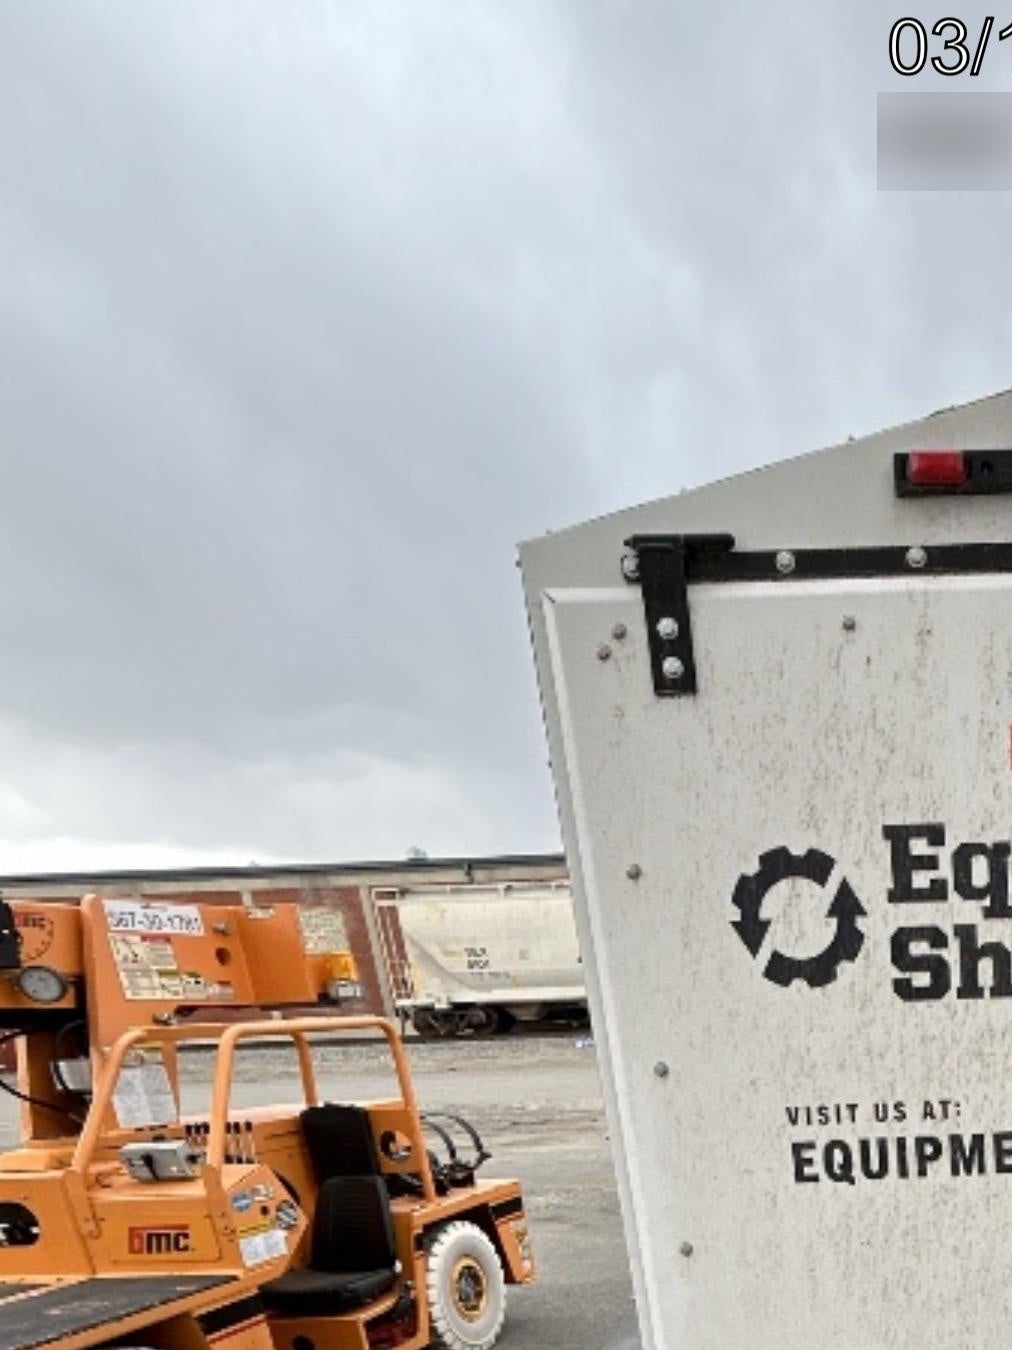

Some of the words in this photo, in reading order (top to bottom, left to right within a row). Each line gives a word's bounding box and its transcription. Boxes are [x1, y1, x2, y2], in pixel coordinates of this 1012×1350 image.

[786, 1104, 858, 1126] VISIT
[874, 1101, 907, 1123] US
[922, 1100, 961, 1121] AT:
